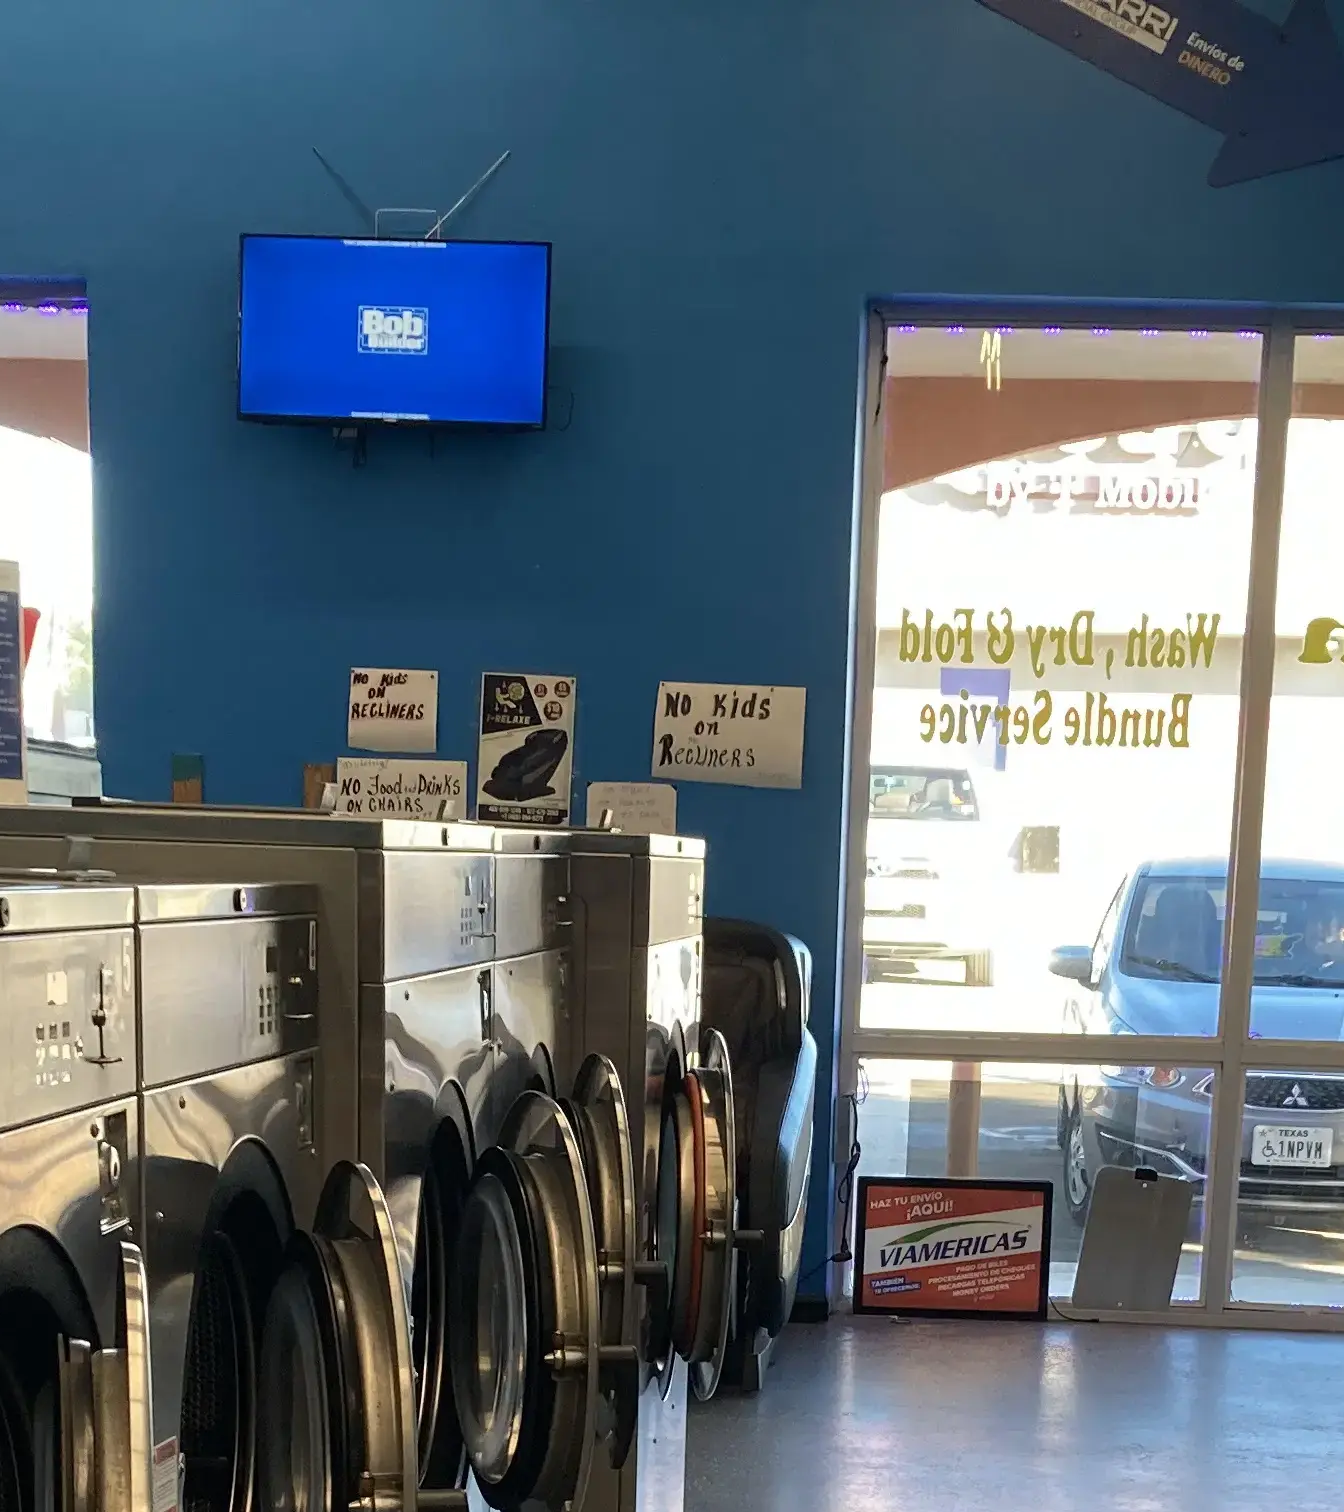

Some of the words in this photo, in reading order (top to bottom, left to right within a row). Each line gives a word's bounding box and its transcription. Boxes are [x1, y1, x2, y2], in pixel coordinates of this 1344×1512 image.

[1178, 50, 1231, 86] DINERO
[1227, 55, 1245, 72] de
[363, 310, 423, 335] Bob
[353, 673, 369, 685] NO
[664, 691, 692, 717] NO
[712, 690, 771, 720] Kids
[340, 777, 361, 796] NO
[1278, 1129, 1309, 1137] TEXAS
[870, 1198, 892, 1210] HAZ
[894, 1196, 908, 1207] TU
[879, 1229, 1030, 1268] VIAMERICAS
[976, 1262, 986, 1270] DE
[1000, 1263, 1036, 1275] CHEQUES
[952, 1287, 978, 1298] MONEY
[980, 1283, 1010, 1295] ORDERS
